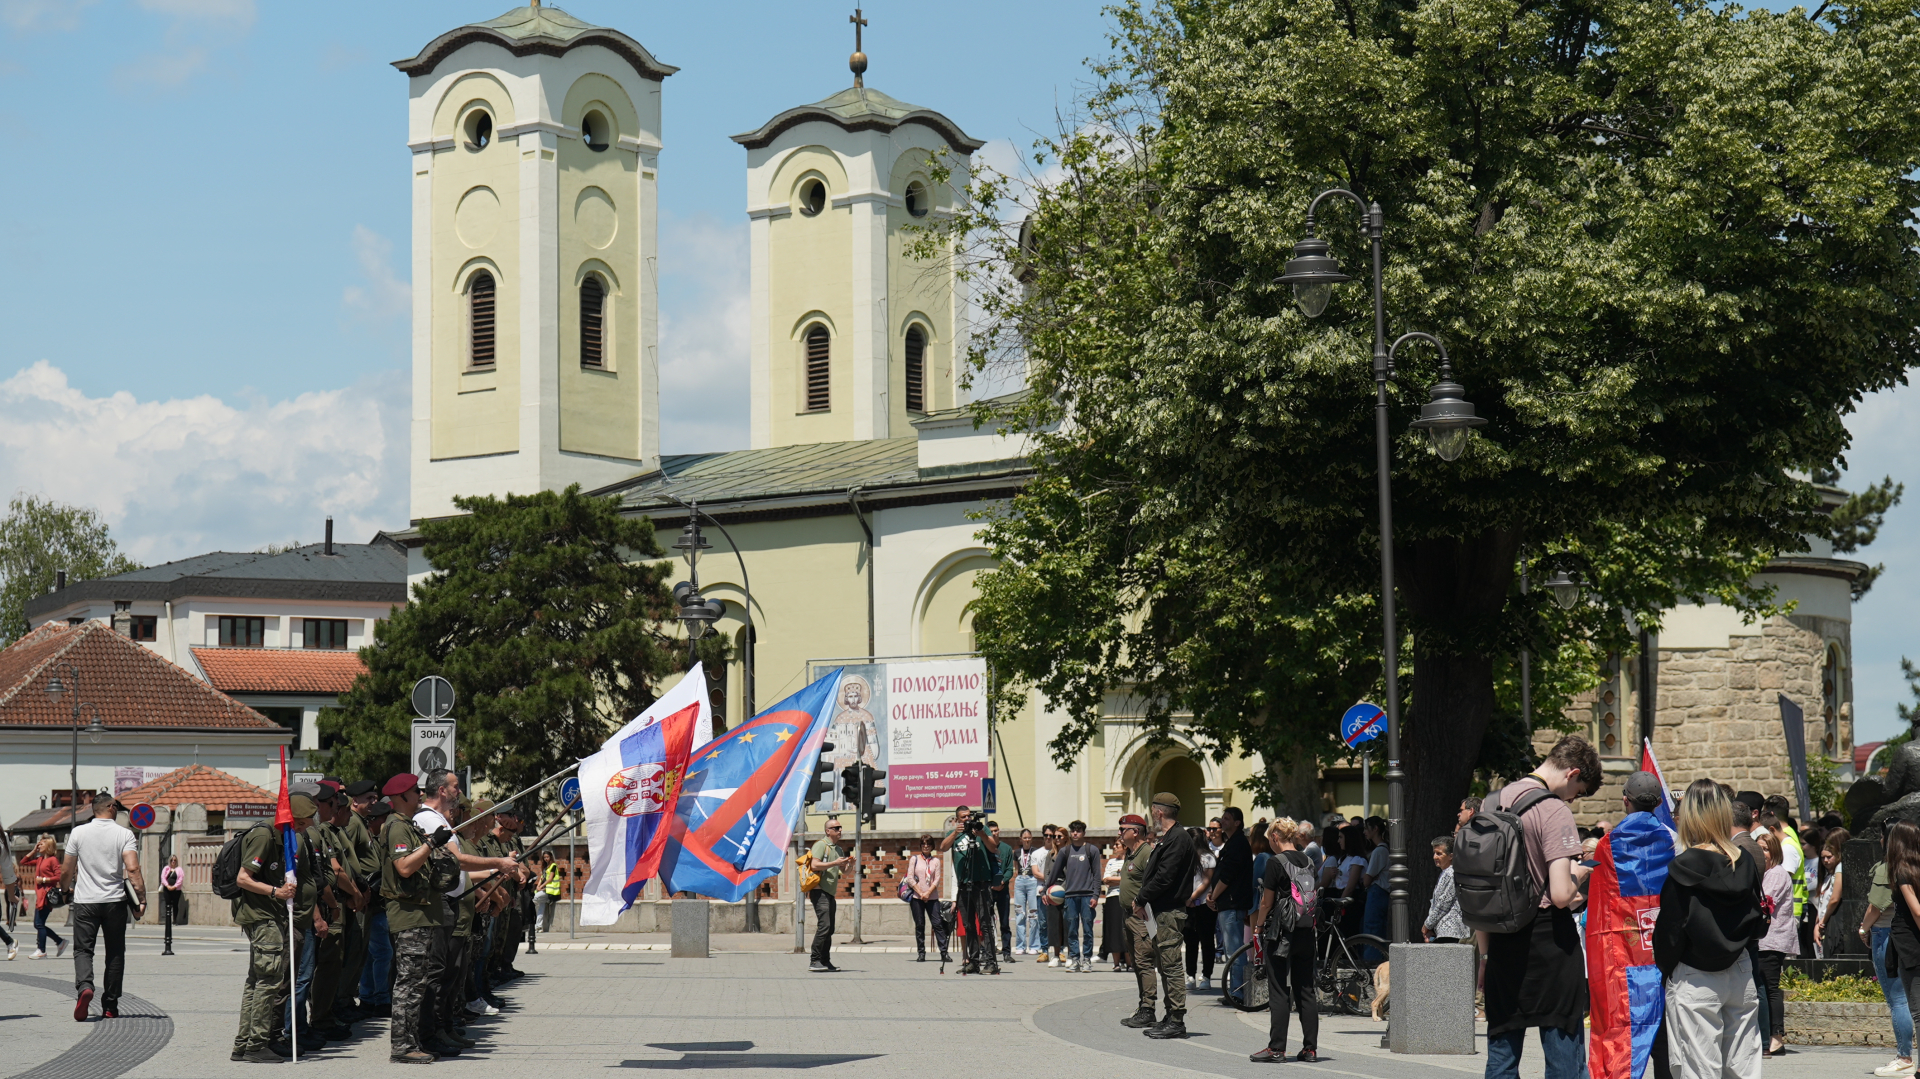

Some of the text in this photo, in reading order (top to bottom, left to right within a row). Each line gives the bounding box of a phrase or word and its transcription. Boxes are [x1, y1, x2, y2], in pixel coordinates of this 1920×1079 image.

[420, 730, 446, 739] ЗОНА
[925, 771, 939, 779] 155
[945, 770, 963, 779] 4699
[969, 769, 979, 778] 75
